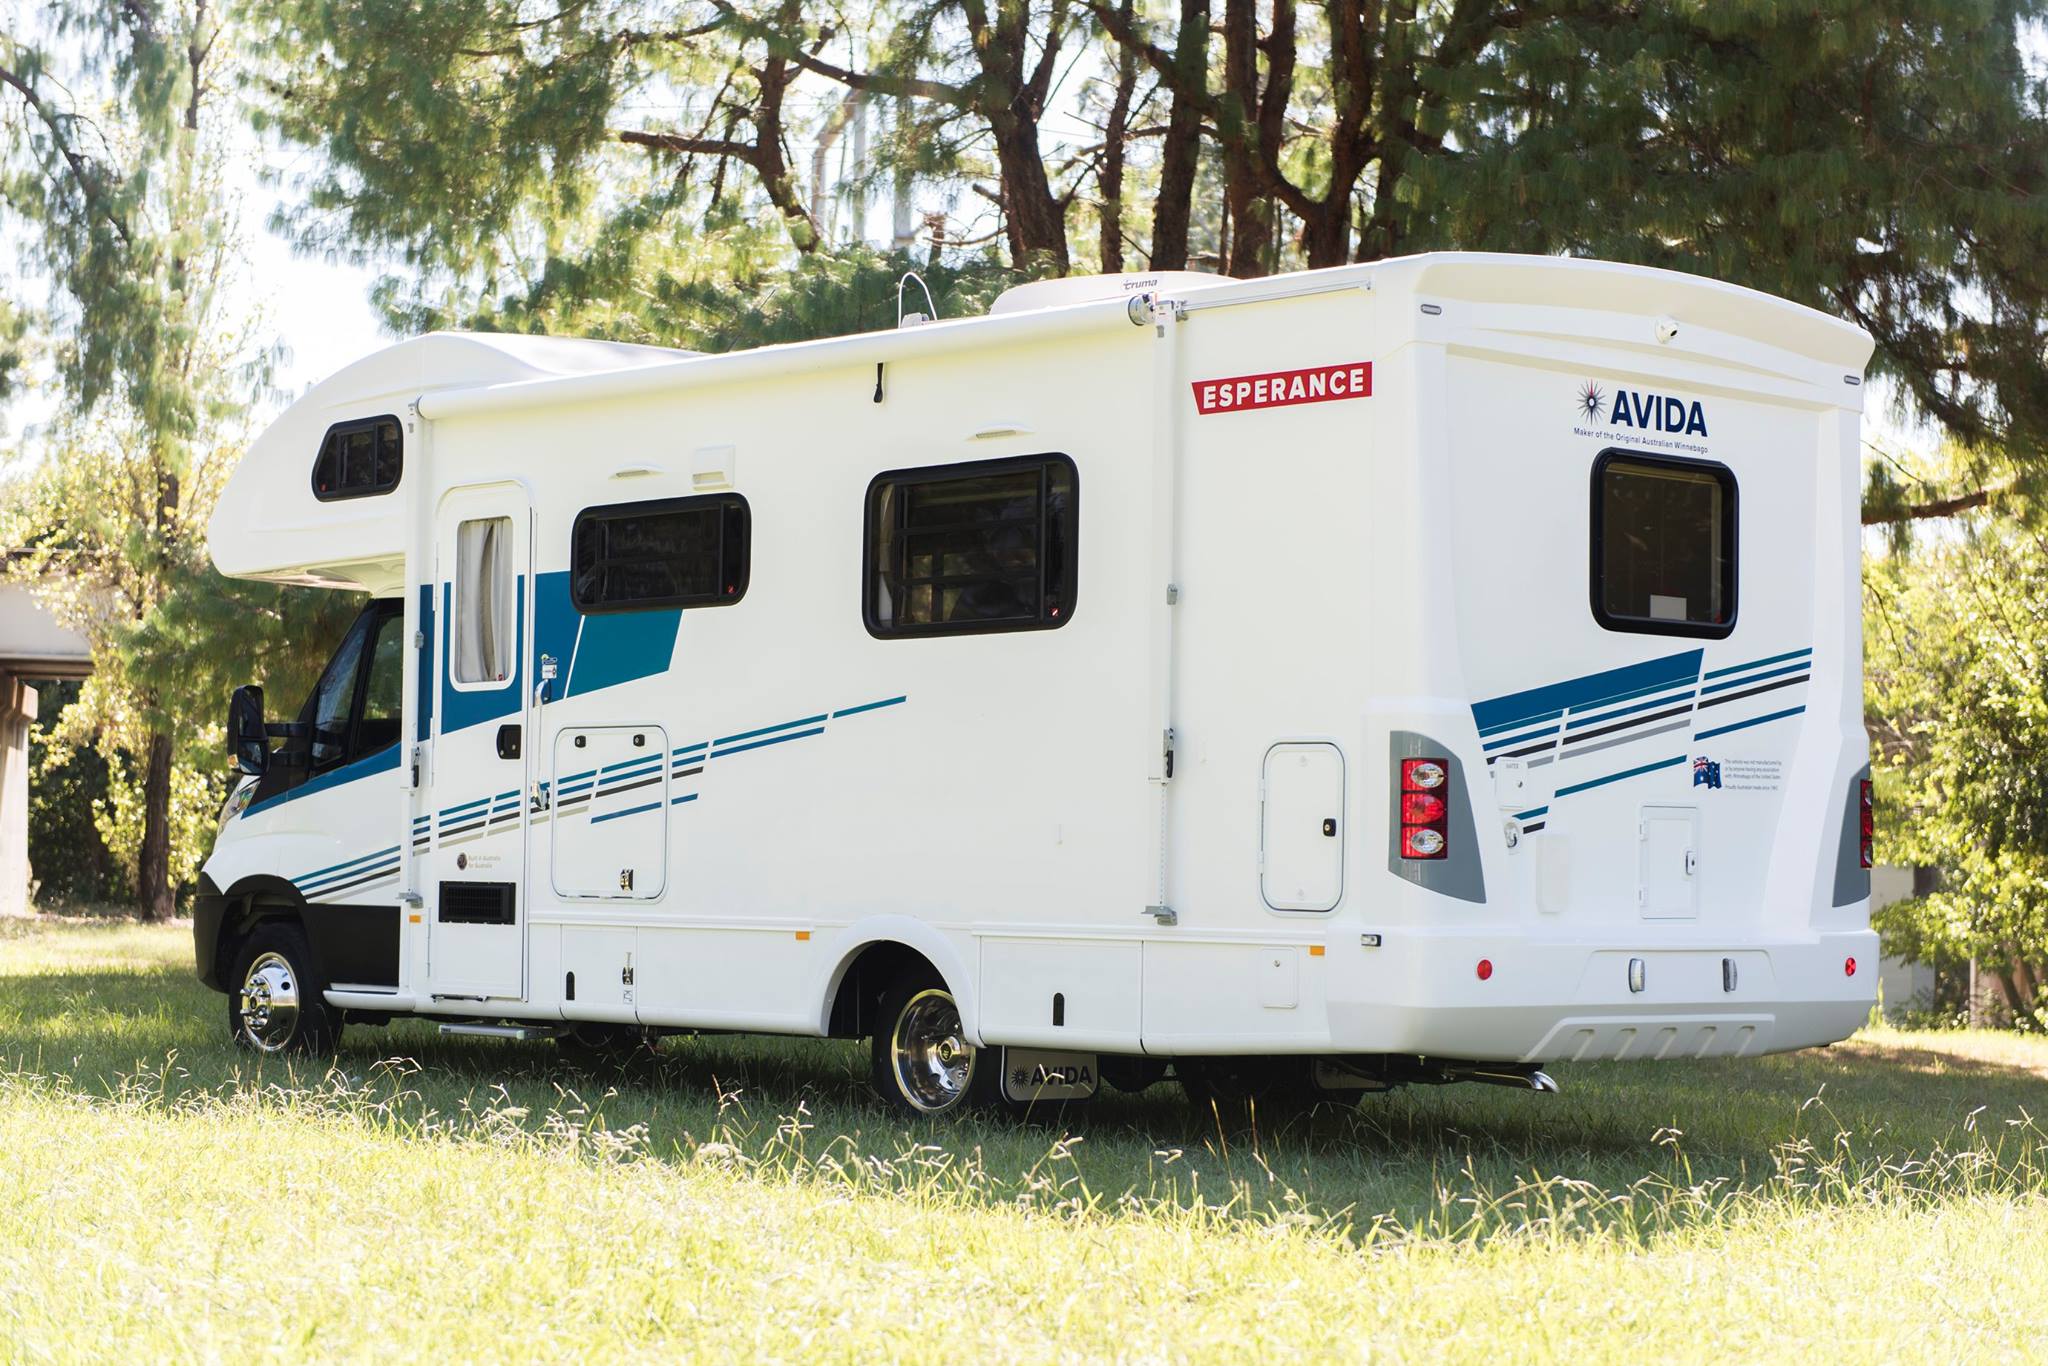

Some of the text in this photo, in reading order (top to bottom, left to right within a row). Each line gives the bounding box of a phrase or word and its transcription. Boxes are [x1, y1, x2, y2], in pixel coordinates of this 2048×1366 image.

[1123, 279, 1158, 290] truma
[1202, 368, 1364, 409] ESPERANCE
[1610, 390, 1708, 438] AVIDA
[1573, 427, 1709, 455] Maker of the Original Australian Winnebago
[1030, 1066, 1092, 1086] AVIDA
